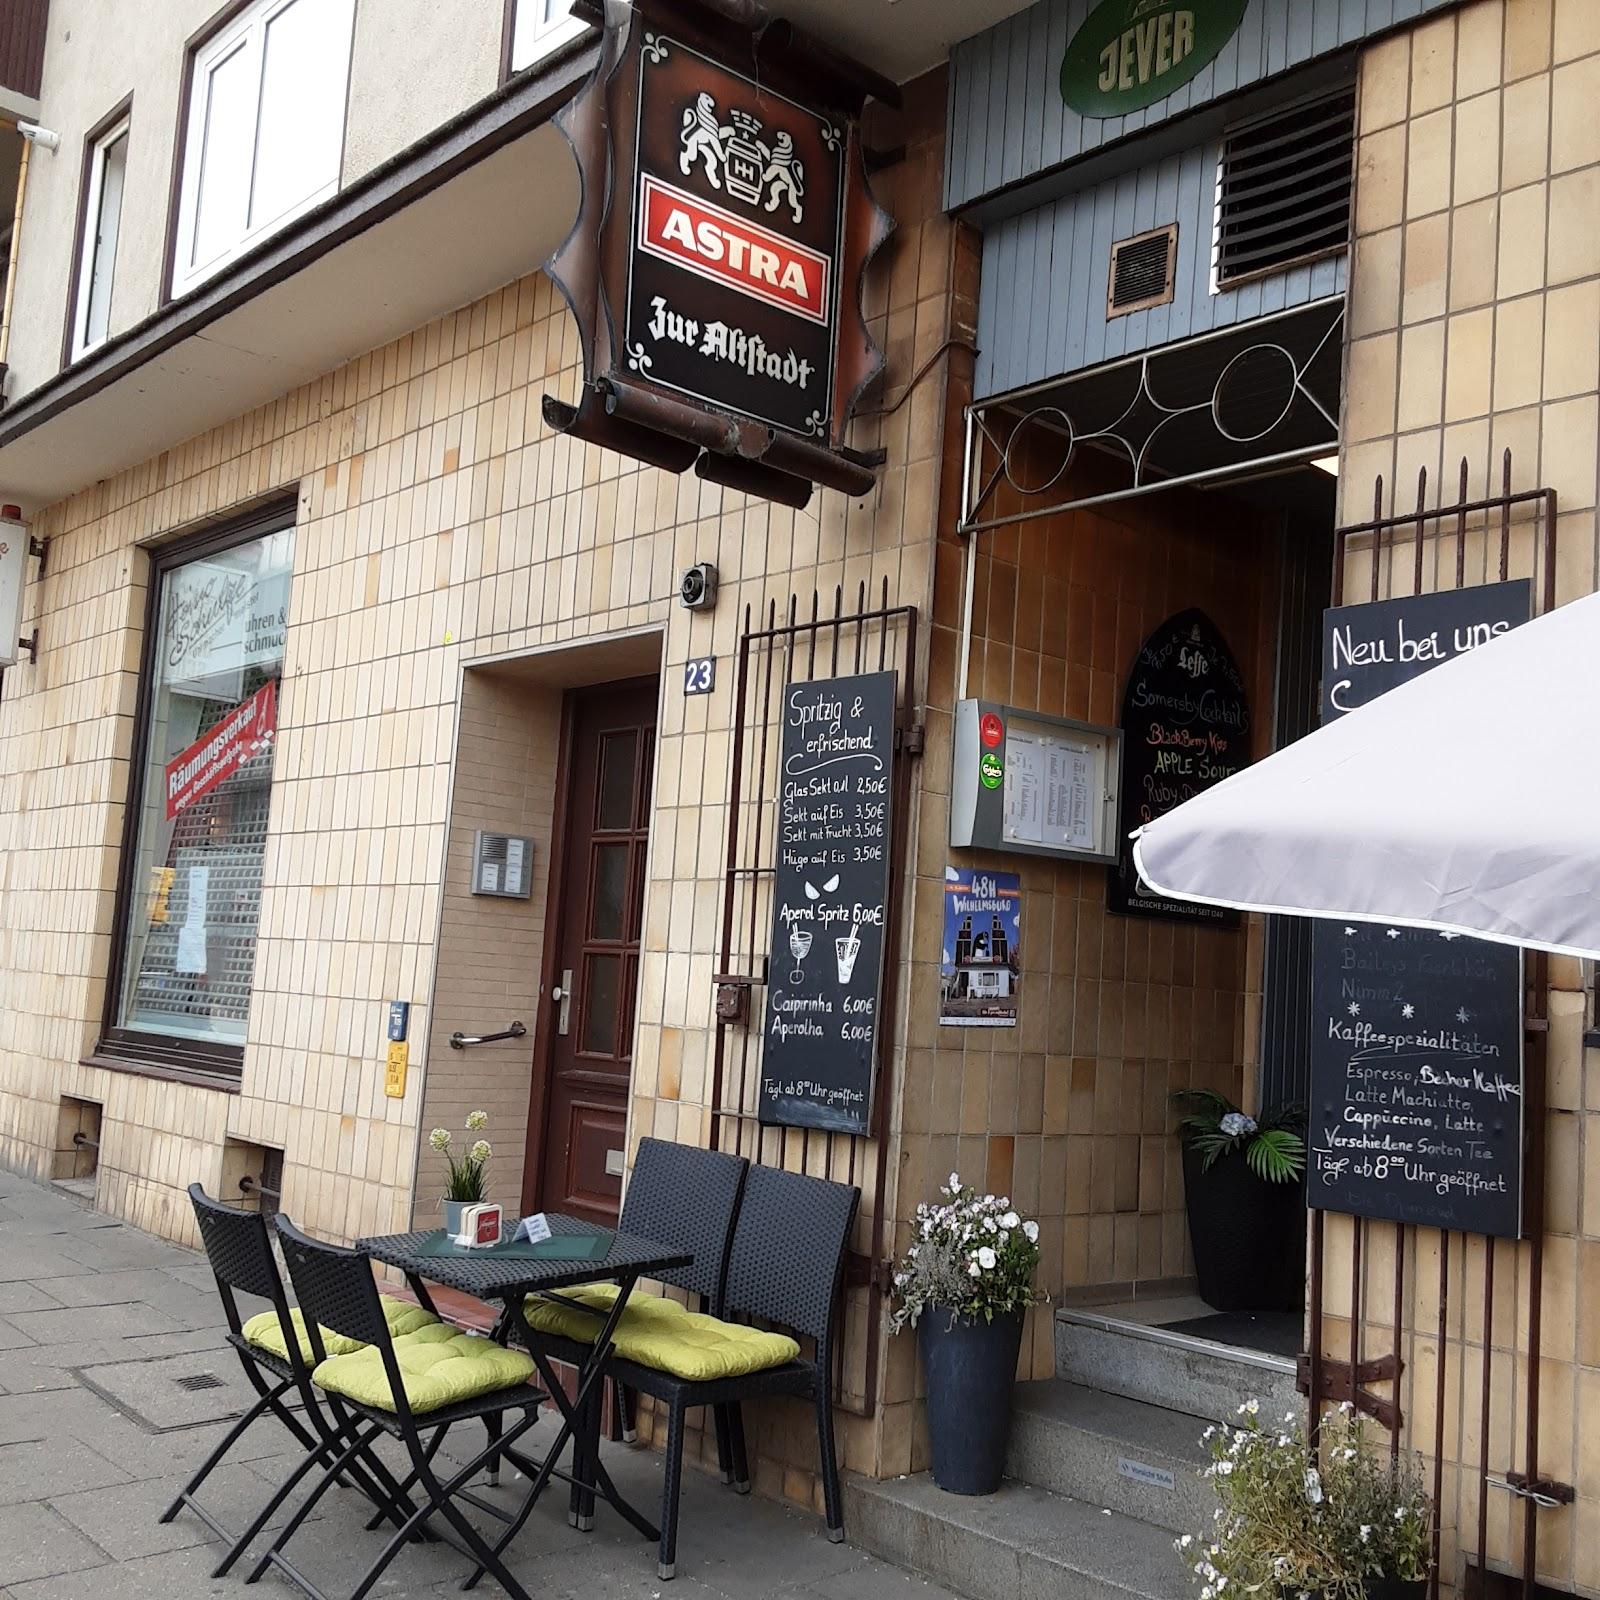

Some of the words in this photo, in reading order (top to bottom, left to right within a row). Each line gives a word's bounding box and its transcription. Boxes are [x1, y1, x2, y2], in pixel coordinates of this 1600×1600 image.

[1098, 10, 1194, 92] JEVER
[661, 209, 809, 299] ASTRA
[648, 295, 699, 347] Zur
[244, 631, 286, 654] schmuc
[1332, 625, 1394, 670] Neu
[1399, 619, 1446, 662] bei
[686, 661, 711, 692] 23
[1177, 647, 1209, 678] Leffe
[790, 690, 842, 739] Spritzig
[850, 696, 864, 718] &
[168, 697, 257, 800] Räumungsverkauf
[806, 725, 874, 759] erfrischend
[1154, 750, 1193, 775] APPLE
[783, 782, 808, 807] Glas
[809, 777, 832, 796] Sekt
[857, 776, 887, 795] 2,50€
[783, 807, 808, 824] Sekt
[811, 804, 829, 825] auf
[830, 804, 844, 819] Eis
[854, 803, 885, 820] 3,50€
[783, 826, 807, 843] Sekt
[810, 827, 824, 840] mit
[824, 824, 852, 840] Frucht
[854, 822, 884, 838] 3,50€
[783, 848, 808, 872] Hugo
[811, 850, 828, 867] auf
[831, 849, 846, 863] Eis
[853, 845, 882, 862] 3,50€
[971, 875, 997, 899] 48H
[779, 903, 815, 929] Aperol
[817, 903, 849, 931] Spritz
[853, 902, 884, 926] 6,00€
[1127, 898, 1162, 910] BELGISCHE
[772, 989, 833, 1019] Caipirinha
[843, 995, 875, 1015] 6,00€
[841, 1022, 873, 1042] 6,00€
[1328, 1017, 1500, 1057] Kaffeespezialitäten
[785, 1081, 795, 1095] ab
[810, 1082, 827, 1098] Uhr
[827, 1087, 864, 1106] geöffnet
[1345, 1084, 1388, 1103] Latte
[1445, 1114, 1484, 1133] Latte
[1325, 1125, 1414, 1153] Verschiedene
[1417, 1138, 1462, 1158] Sorten
[1465, 1140, 1494, 1160] Tee
[1354, 1156, 1373, 1178] ab
[1405, 1162, 1436, 1183] Uhr
[1436, 1171, 1507, 1196] geöffnet
